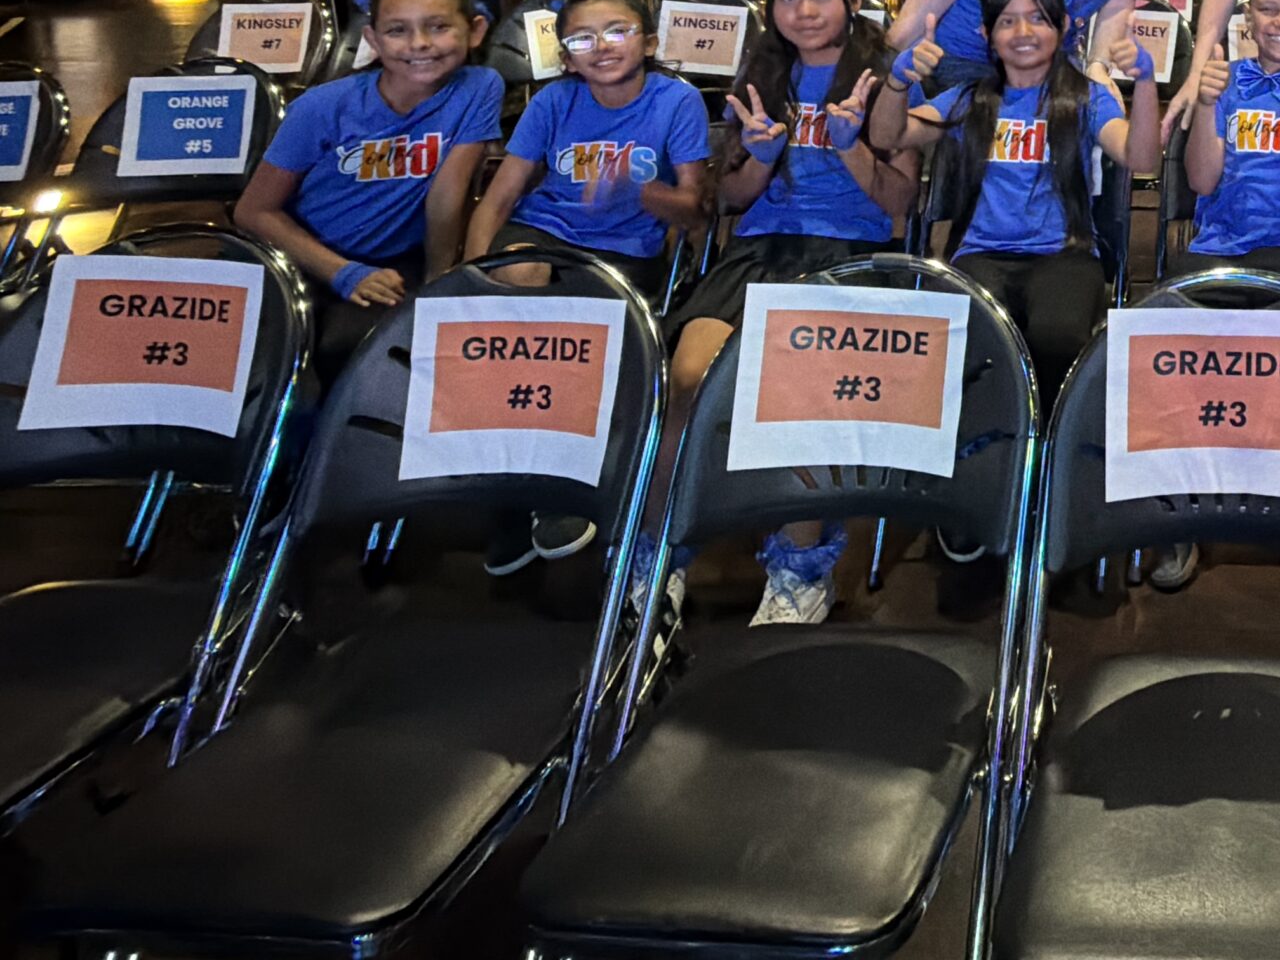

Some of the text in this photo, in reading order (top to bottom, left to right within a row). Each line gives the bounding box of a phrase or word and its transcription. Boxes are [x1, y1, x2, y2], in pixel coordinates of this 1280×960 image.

[236, 17, 302, 31] KINGSLEY
[672, 15, 738, 32] KINGSLEY
[261, 38, 282, 50] #7
[693, 39, 715, 51] #7
[167, 95, 229, 109] ORANGE
[172, 117, 224, 130] GROVE
[184, 139, 212, 153] #5
[988, 119, 1050, 162] Kid
[357, 133, 441, 181] Kid
[100, 294, 230, 323] GRAZIDE
[461, 335, 591, 363] GRAZIDE
[788, 325, 929, 356] GRAZIDE
[142, 341, 189, 367] #3
[507, 383, 552, 410] #3
[832, 374, 881, 402] #3
[1198, 400, 1248, 429] #3
